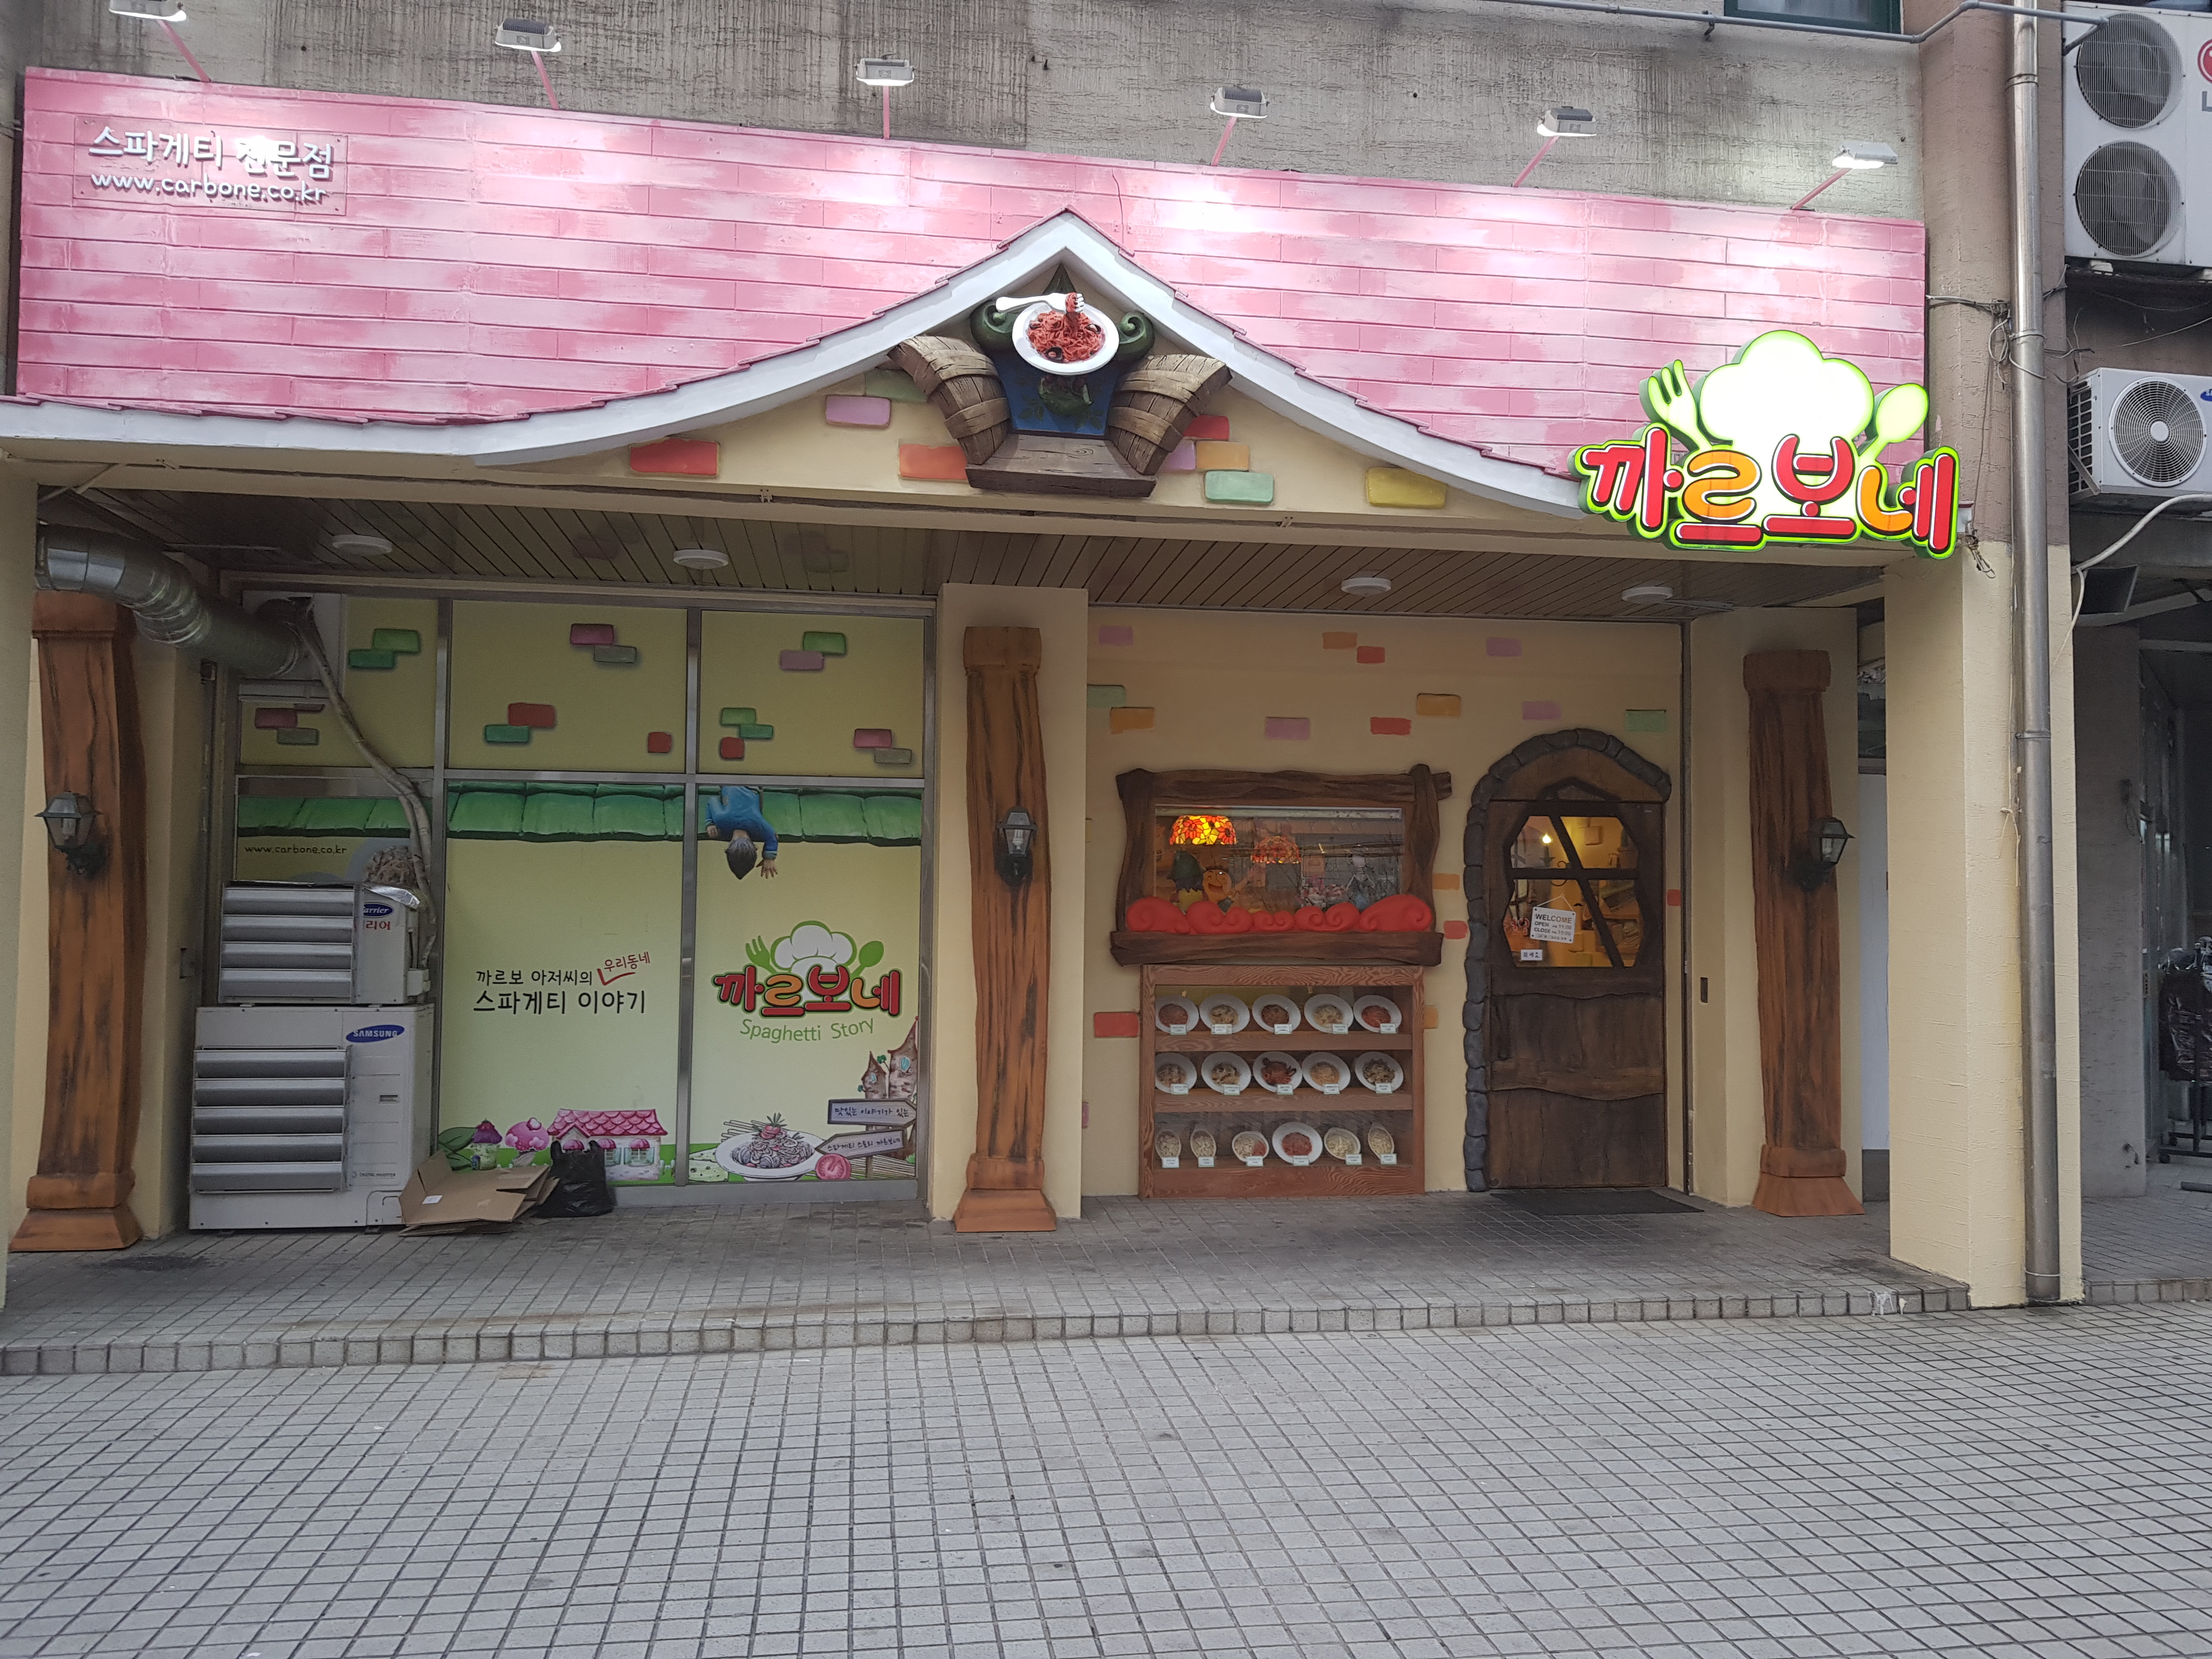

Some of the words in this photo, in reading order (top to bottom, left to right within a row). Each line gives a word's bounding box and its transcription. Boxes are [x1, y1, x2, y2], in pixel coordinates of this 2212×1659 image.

[89, 126, 222, 166] 스파게티
[91, 173, 327, 202] www.carbone.co.kr
[1581, 425, 1956, 554] 까르보네
[245, 844, 347, 854] www.carbone.co.kr
[363, 921, 391, 930] 리어
[1535, 913, 1572, 923] WELCOME
[603, 951, 651, 972] 우리동네
[476, 969, 524, 986] 까르보
[531, 969, 592, 986] 아저씨의
[713, 964, 901, 1018] 까르보네
[473, 990, 566, 1015] 스파게티
[578, 990, 645, 1014] 이야기
[740, 1019, 821, 1043] Spaghetti
[831, 1018, 874, 1039] Story
[834, 1107, 857, 1116] 맛있는
[896, 1108, 909, 1118] 있는
[827, 1143, 855, 1152] 스파게티
